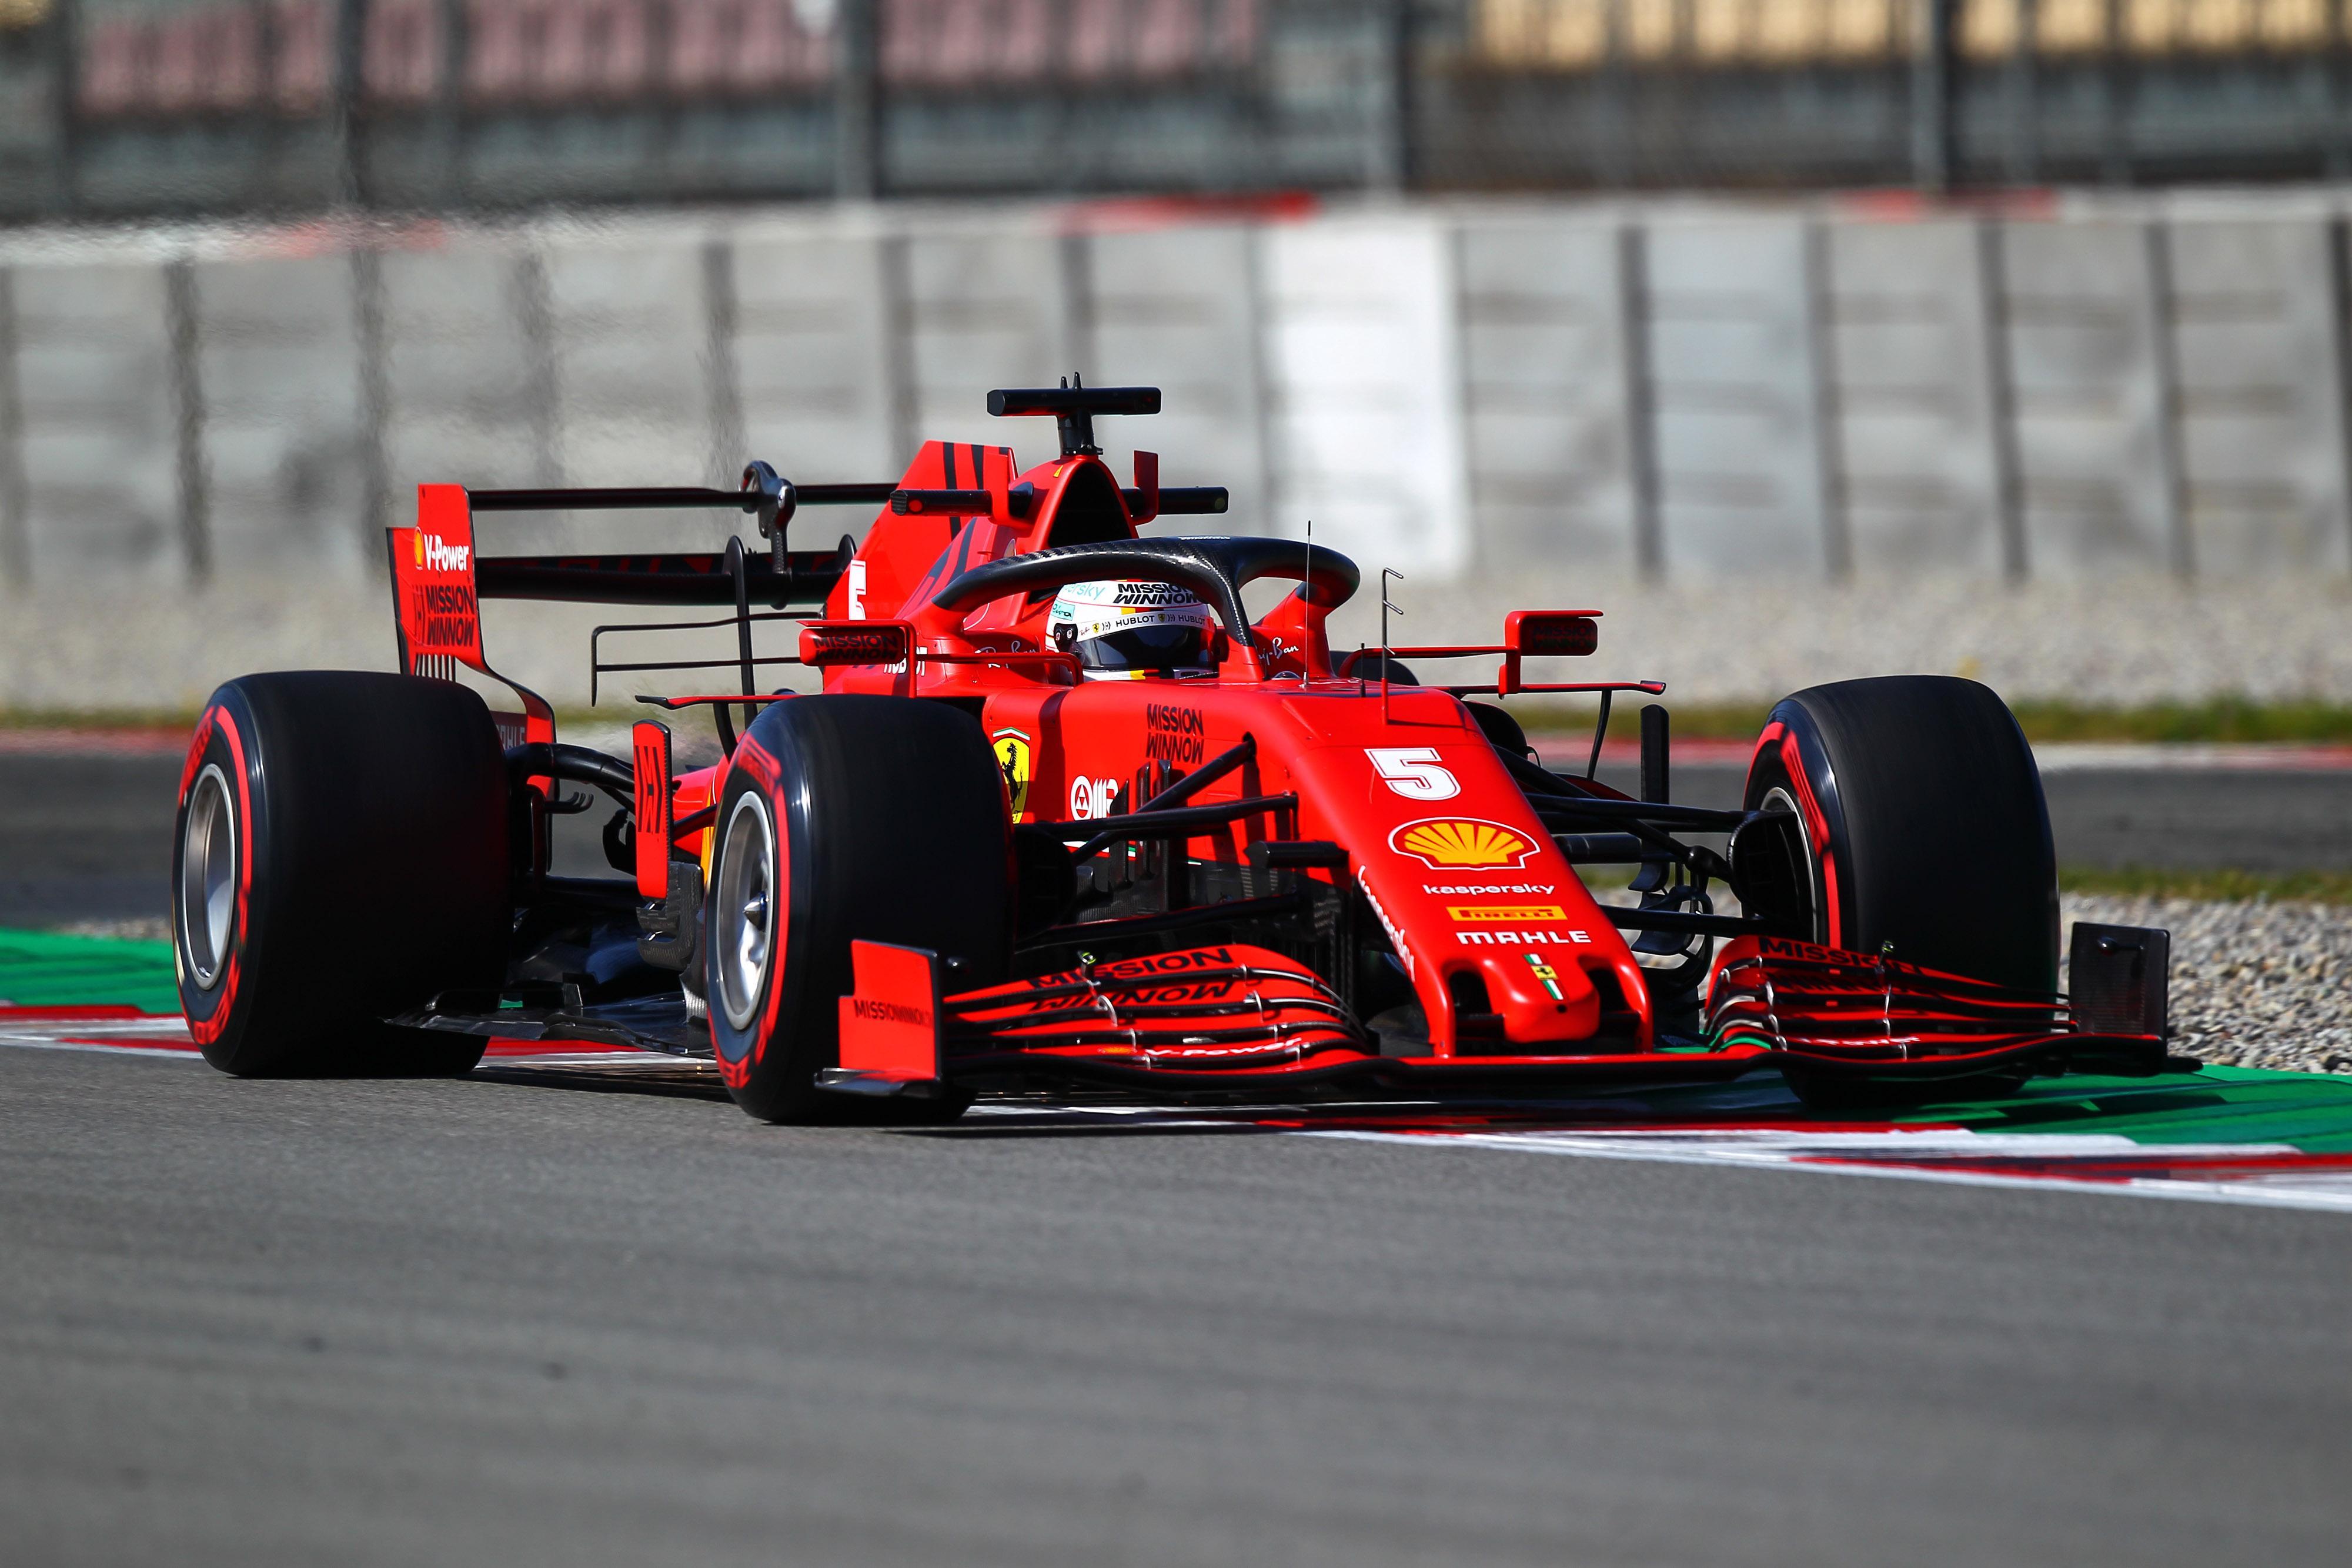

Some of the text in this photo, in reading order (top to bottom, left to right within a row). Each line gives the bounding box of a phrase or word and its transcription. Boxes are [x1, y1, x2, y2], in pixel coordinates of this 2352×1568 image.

[425, 534, 469, 571] V-Power
[426, 585, 475, 614] MISSION
[427, 617, 475, 647] WINNOW
[1115, 615, 1155, 627] HUBLOT
[813, 635, 897, 648] MISSION
[1147, 703, 1204, 736] MISSION
[1145, 733, 1204, 765] WINNOW
[1364, 747, 1461, 801] 5
[1422, 884, 1555, 895] kaspersky
[1455, 931, 1592, 945] MAHLE
